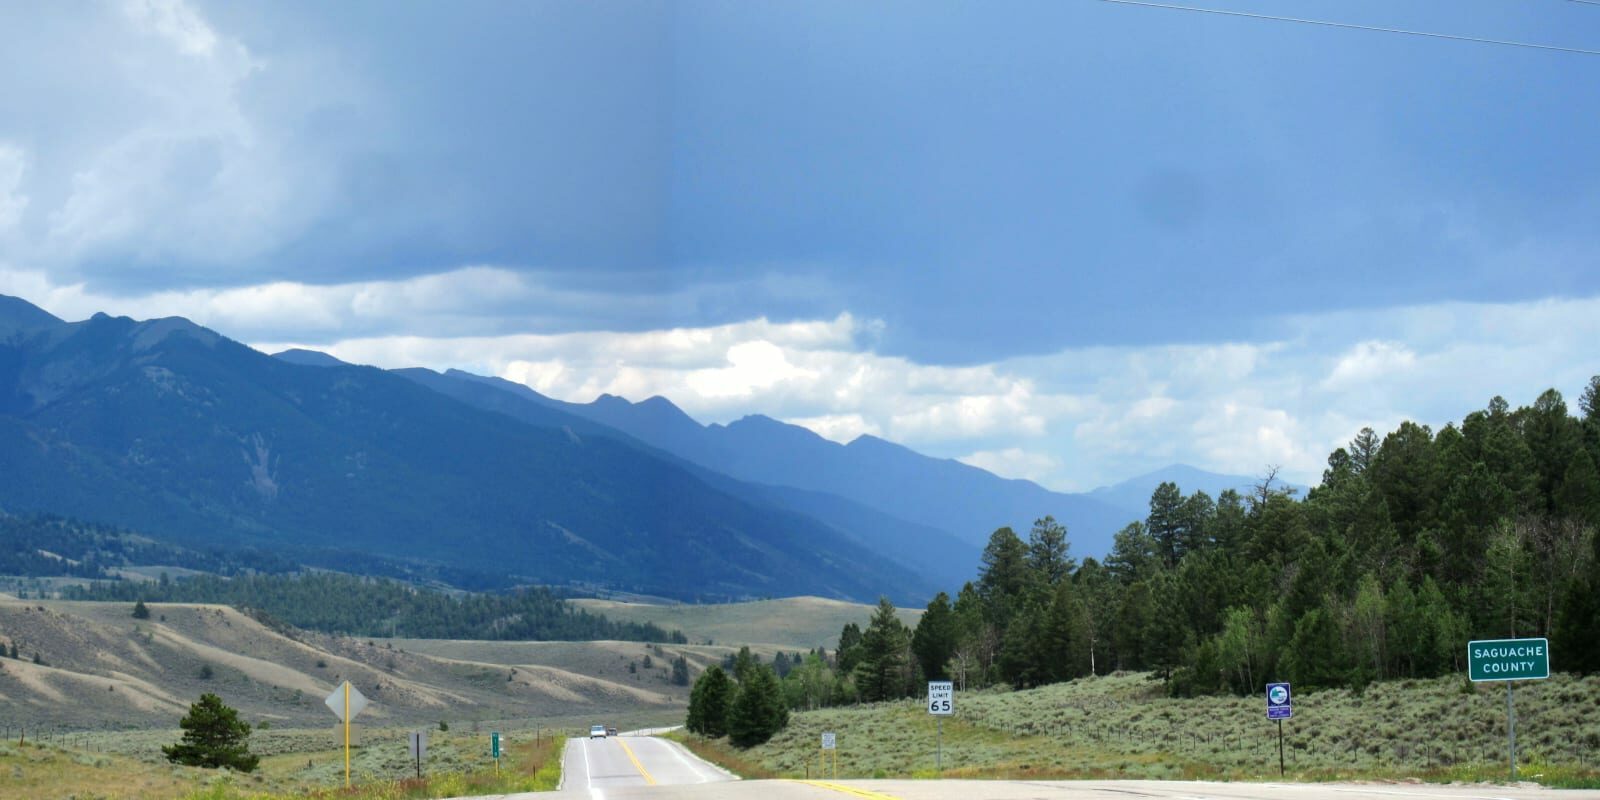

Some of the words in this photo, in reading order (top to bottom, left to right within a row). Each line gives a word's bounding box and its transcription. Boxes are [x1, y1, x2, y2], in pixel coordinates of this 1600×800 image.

[1474, 646, 1543, 659] SAGUACHE
[1483, 661, 1535, 673] COUNTY
[931, 700, 951, 711] 65
